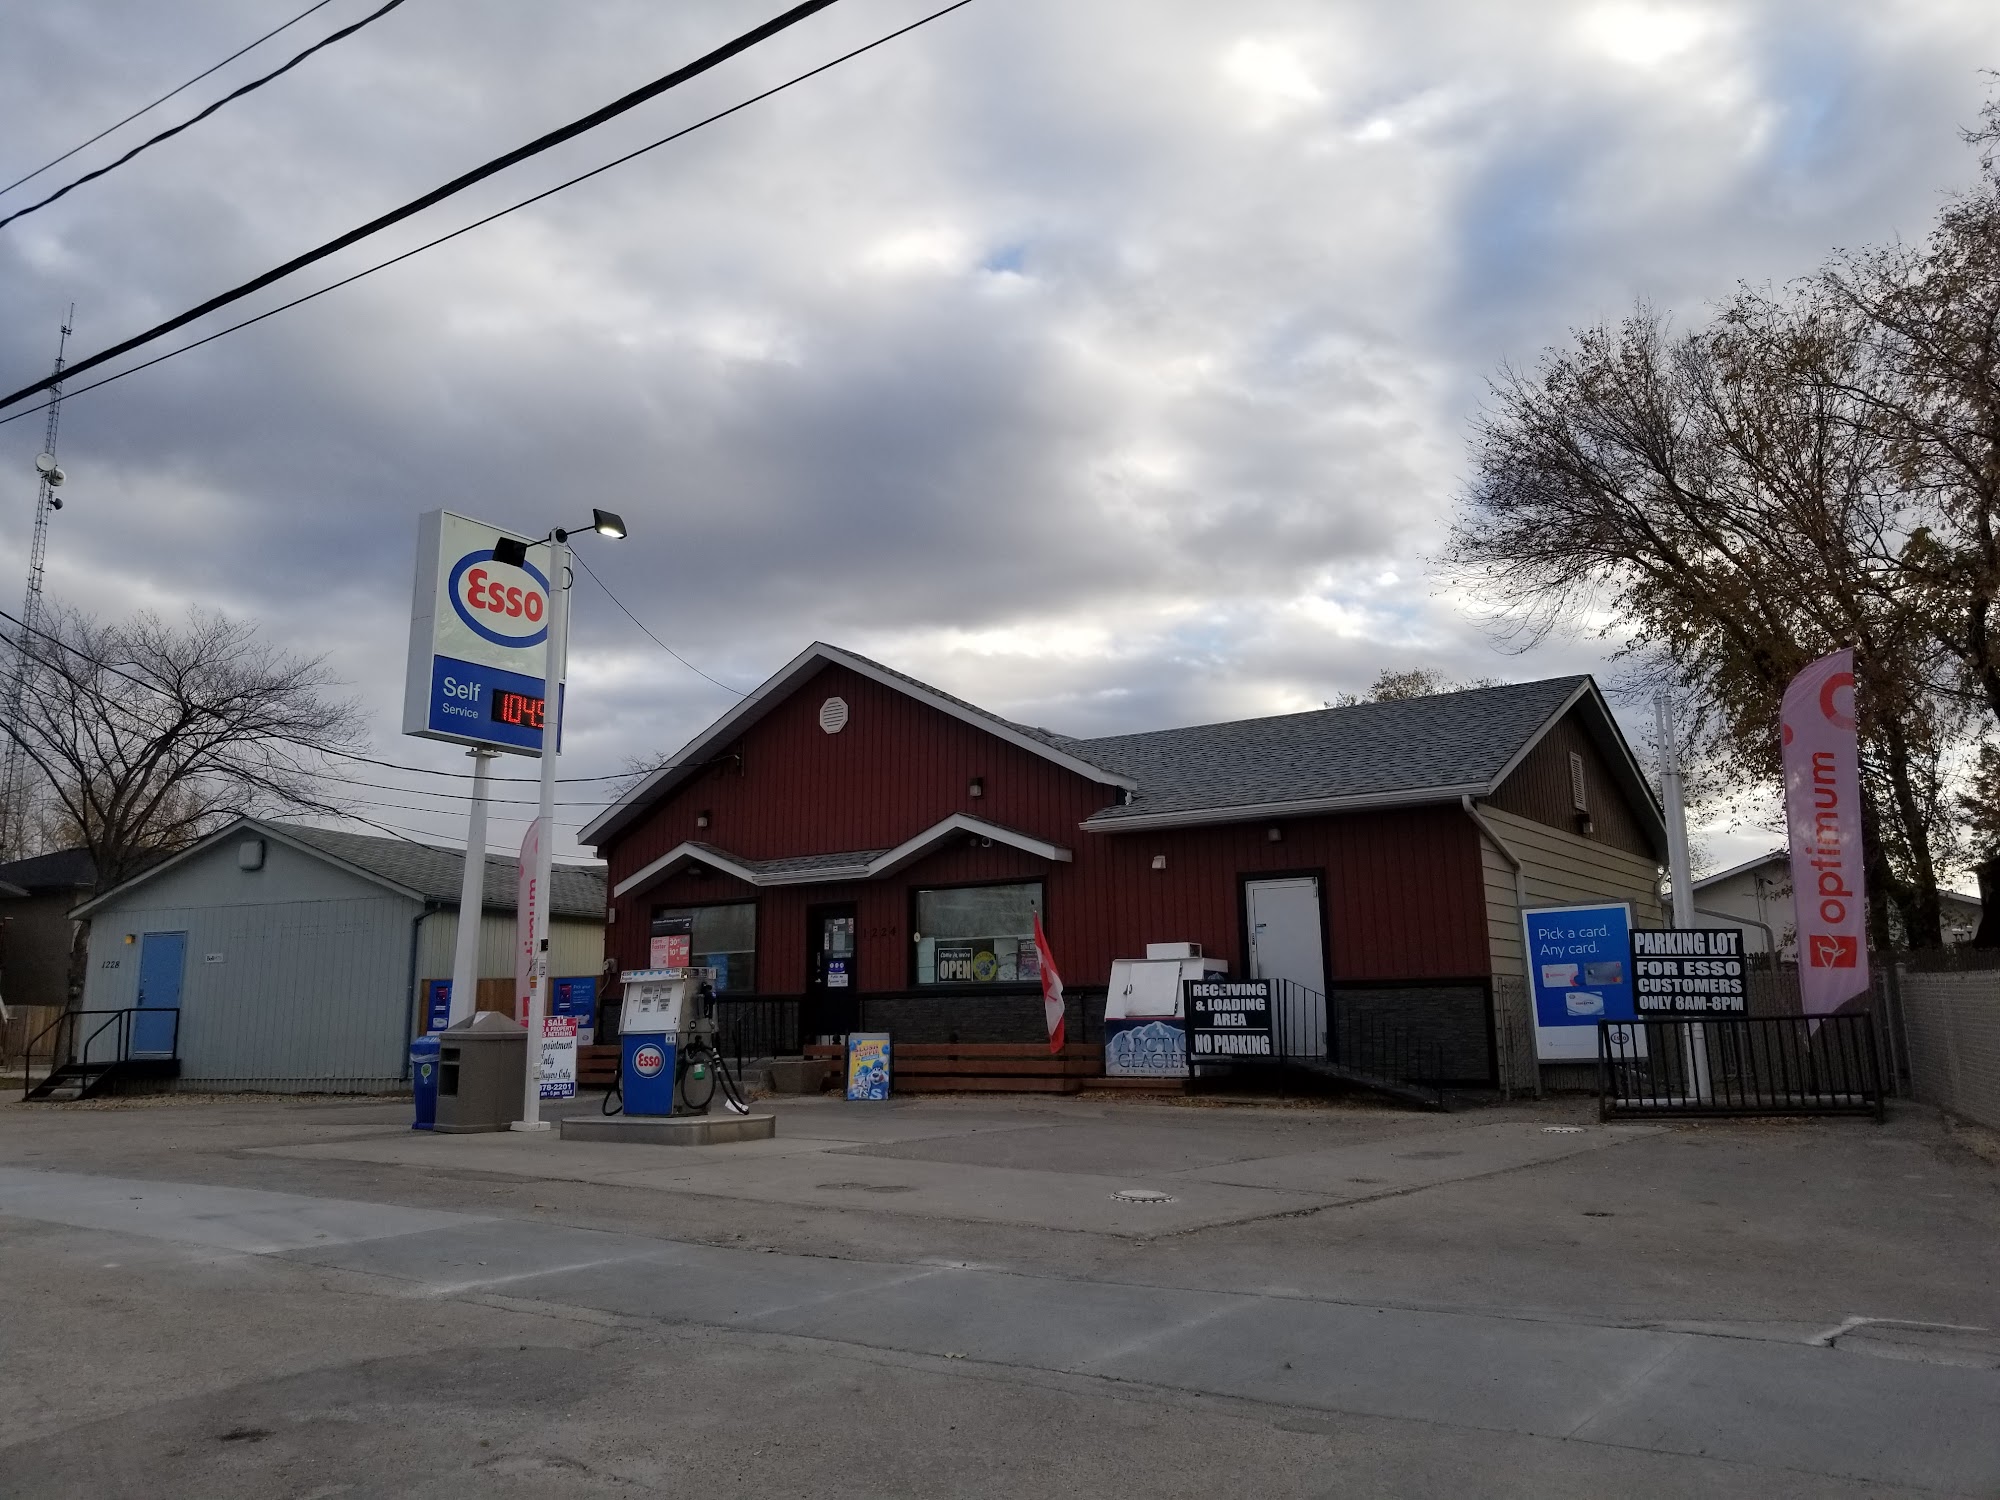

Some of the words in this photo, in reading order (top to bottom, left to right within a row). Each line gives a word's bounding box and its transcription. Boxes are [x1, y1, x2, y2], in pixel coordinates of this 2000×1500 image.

[467, 568, 543, 622] Esso
[443, 677, 481, 701] Self
[442, 702, 479, 719] Service
[1806, 752, 1853, 924] optimum
[863, 927, 896, 938] 1224
[1538, 927, 1564, 940] Pick
[1568, 930, 1576, 938] a
[1579, 924, 1611, 938] card.
[1540, 944, 1565, 958] Any
[1568, 941, 1600, 954] card.
[1634, 932, 1706, 954] PARKING
[1708, 932, 1738, 954] LOT
[101, 961, 120, 969] 1228
[940, 960, 971, 979] OPEN
[1636, 961, 1679, 976] FOR
[1683, 961, 1741, 976] ESSO
[1192, 983, 1267, 997] RECEIVING
[1637, 978, 1743, 993] CUSTOMERS
[1195, 1000, 1206, 1011] &
[1207, 998, 1266, 1011] LOADING
[1639, 995, 1672, 1010] ONLY
[1675, 995, 1744, 1011] 8AM-8PM
[1213, 1013, 1247, 1026] AREA
[1194, 1033, 1212, 1054] NO
[1214, 1034, 1270, 1055] PARKING
[638, 1052, 660, 1067] Esso
